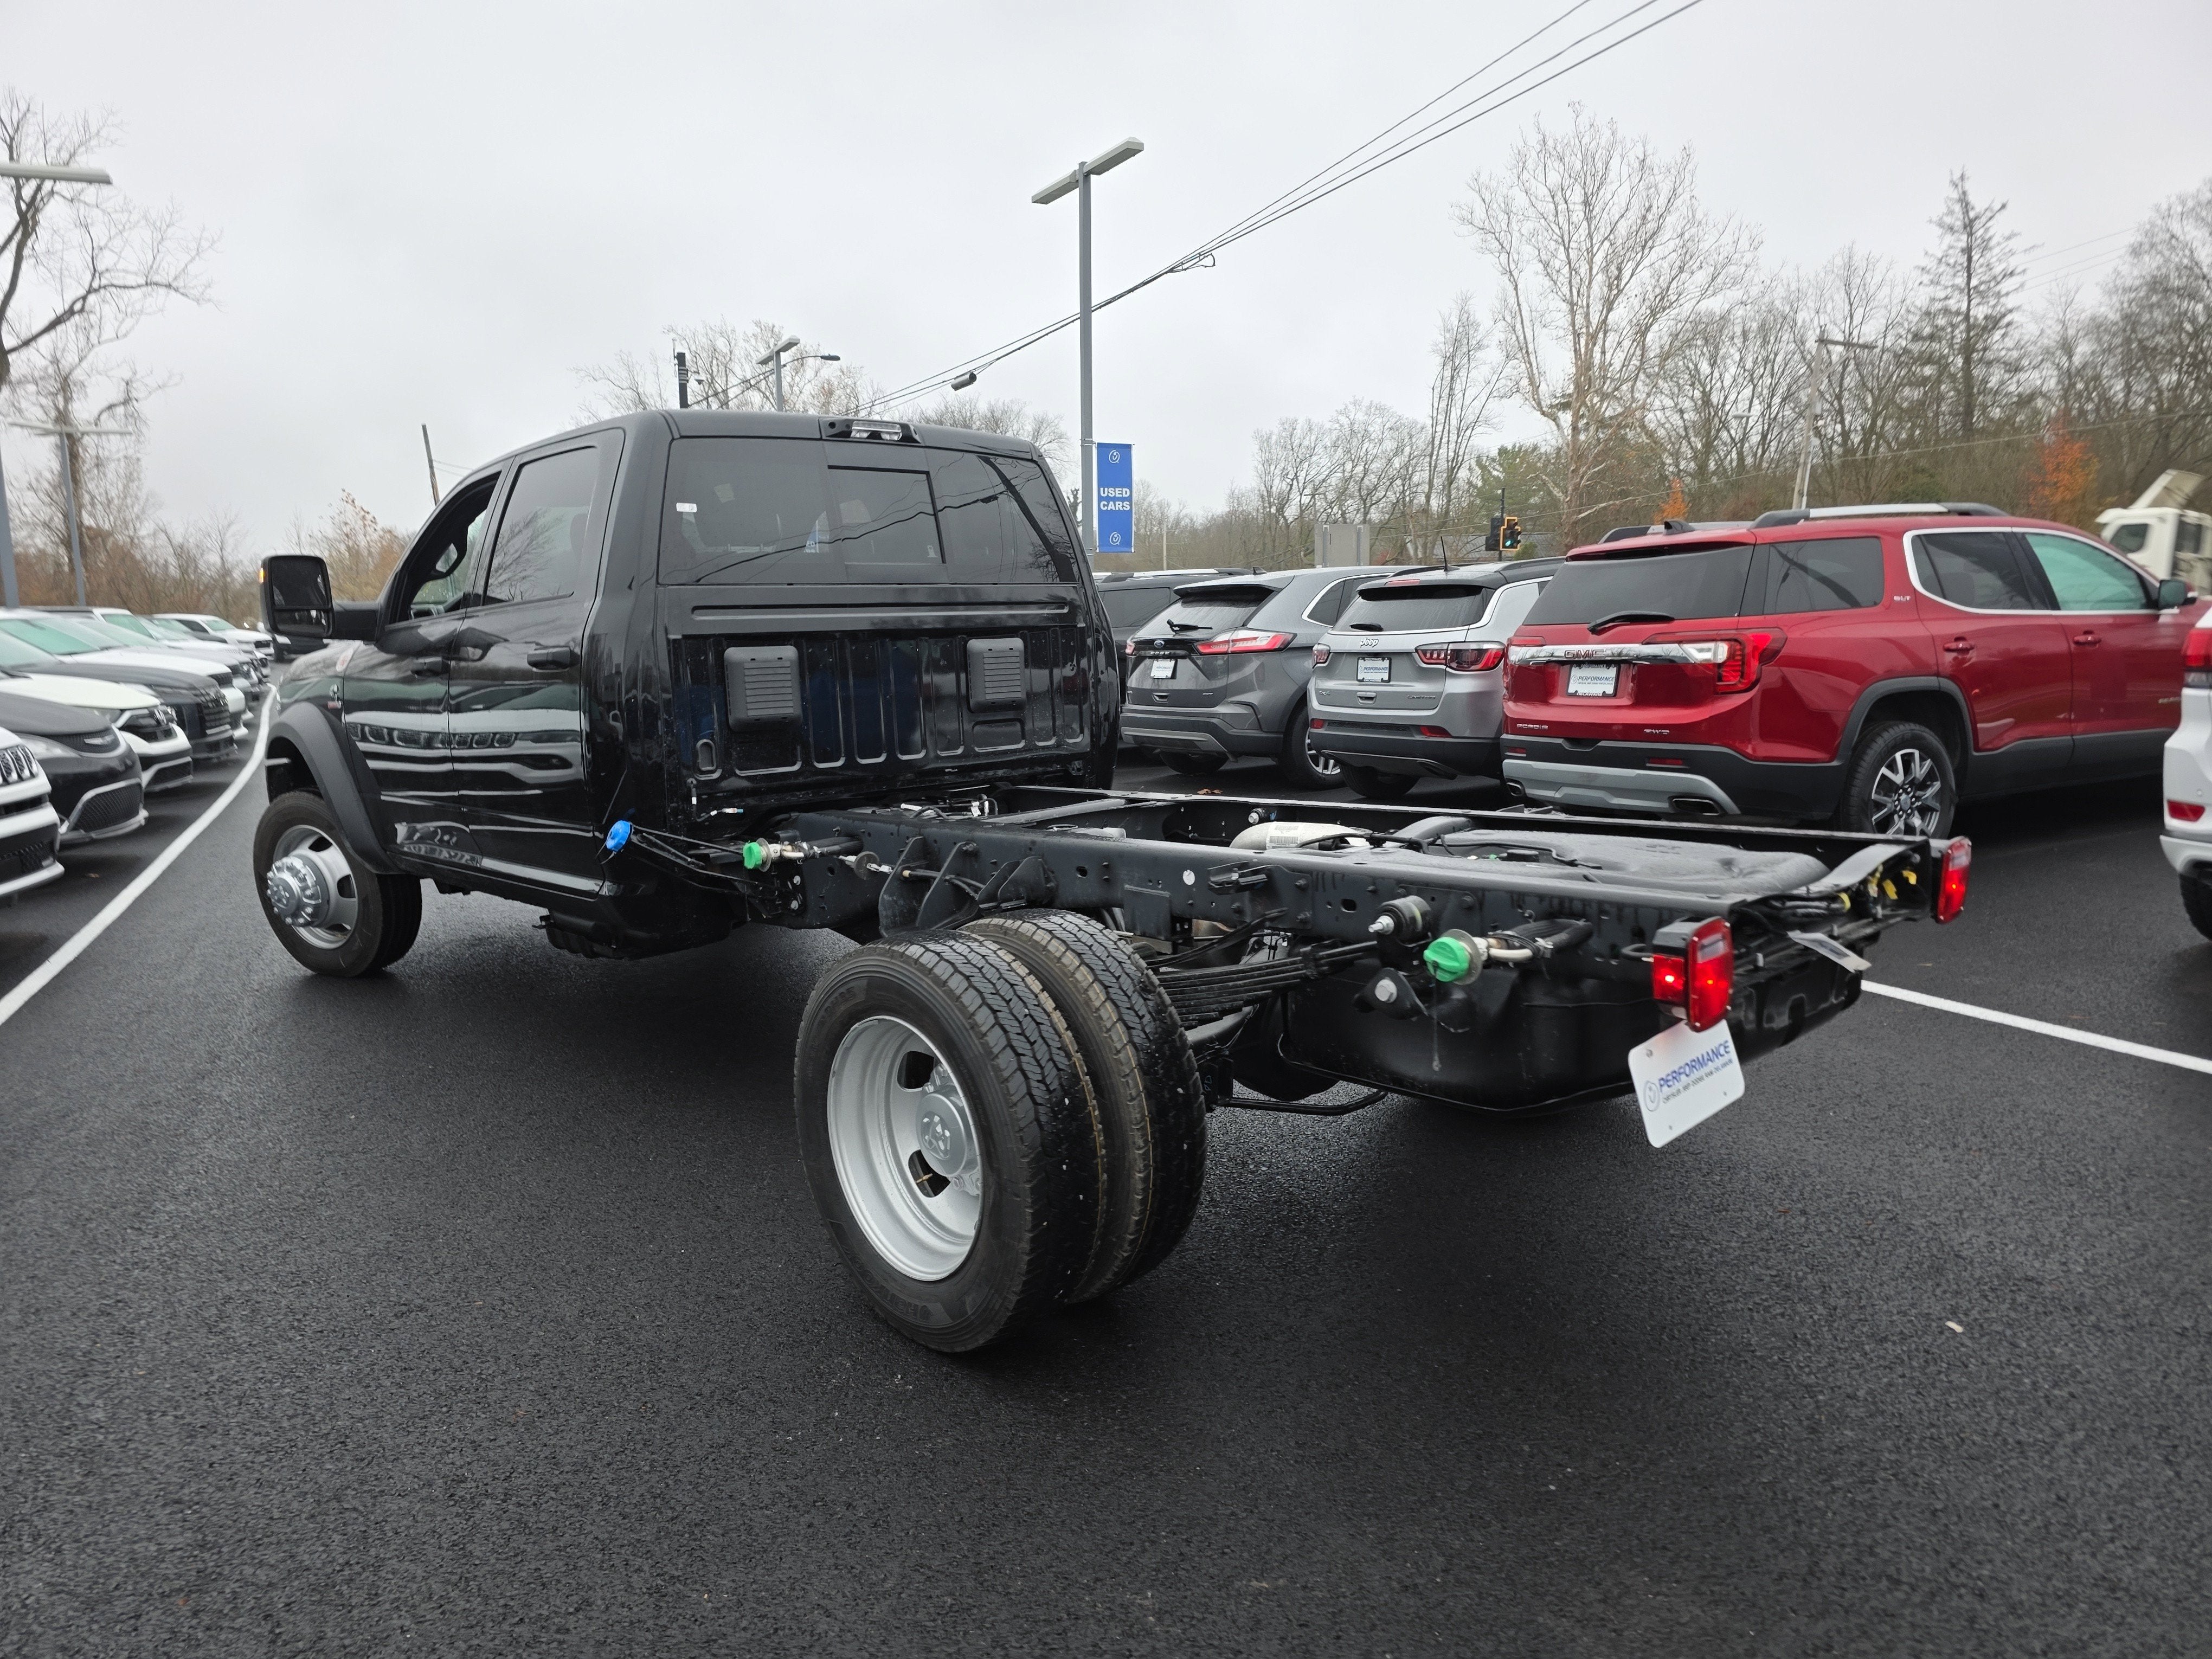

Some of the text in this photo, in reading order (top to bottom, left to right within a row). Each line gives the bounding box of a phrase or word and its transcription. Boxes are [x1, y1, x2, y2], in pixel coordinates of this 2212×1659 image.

[1100, 487, 1130, 497] USED
[1100, 501, 1130, 511] CARS
[1360, 637, 1379, 648] Jeep
[1565, 649, 1606, 659] GMC
[1658, 1040, 1731, 1094] PERFORMANCE
